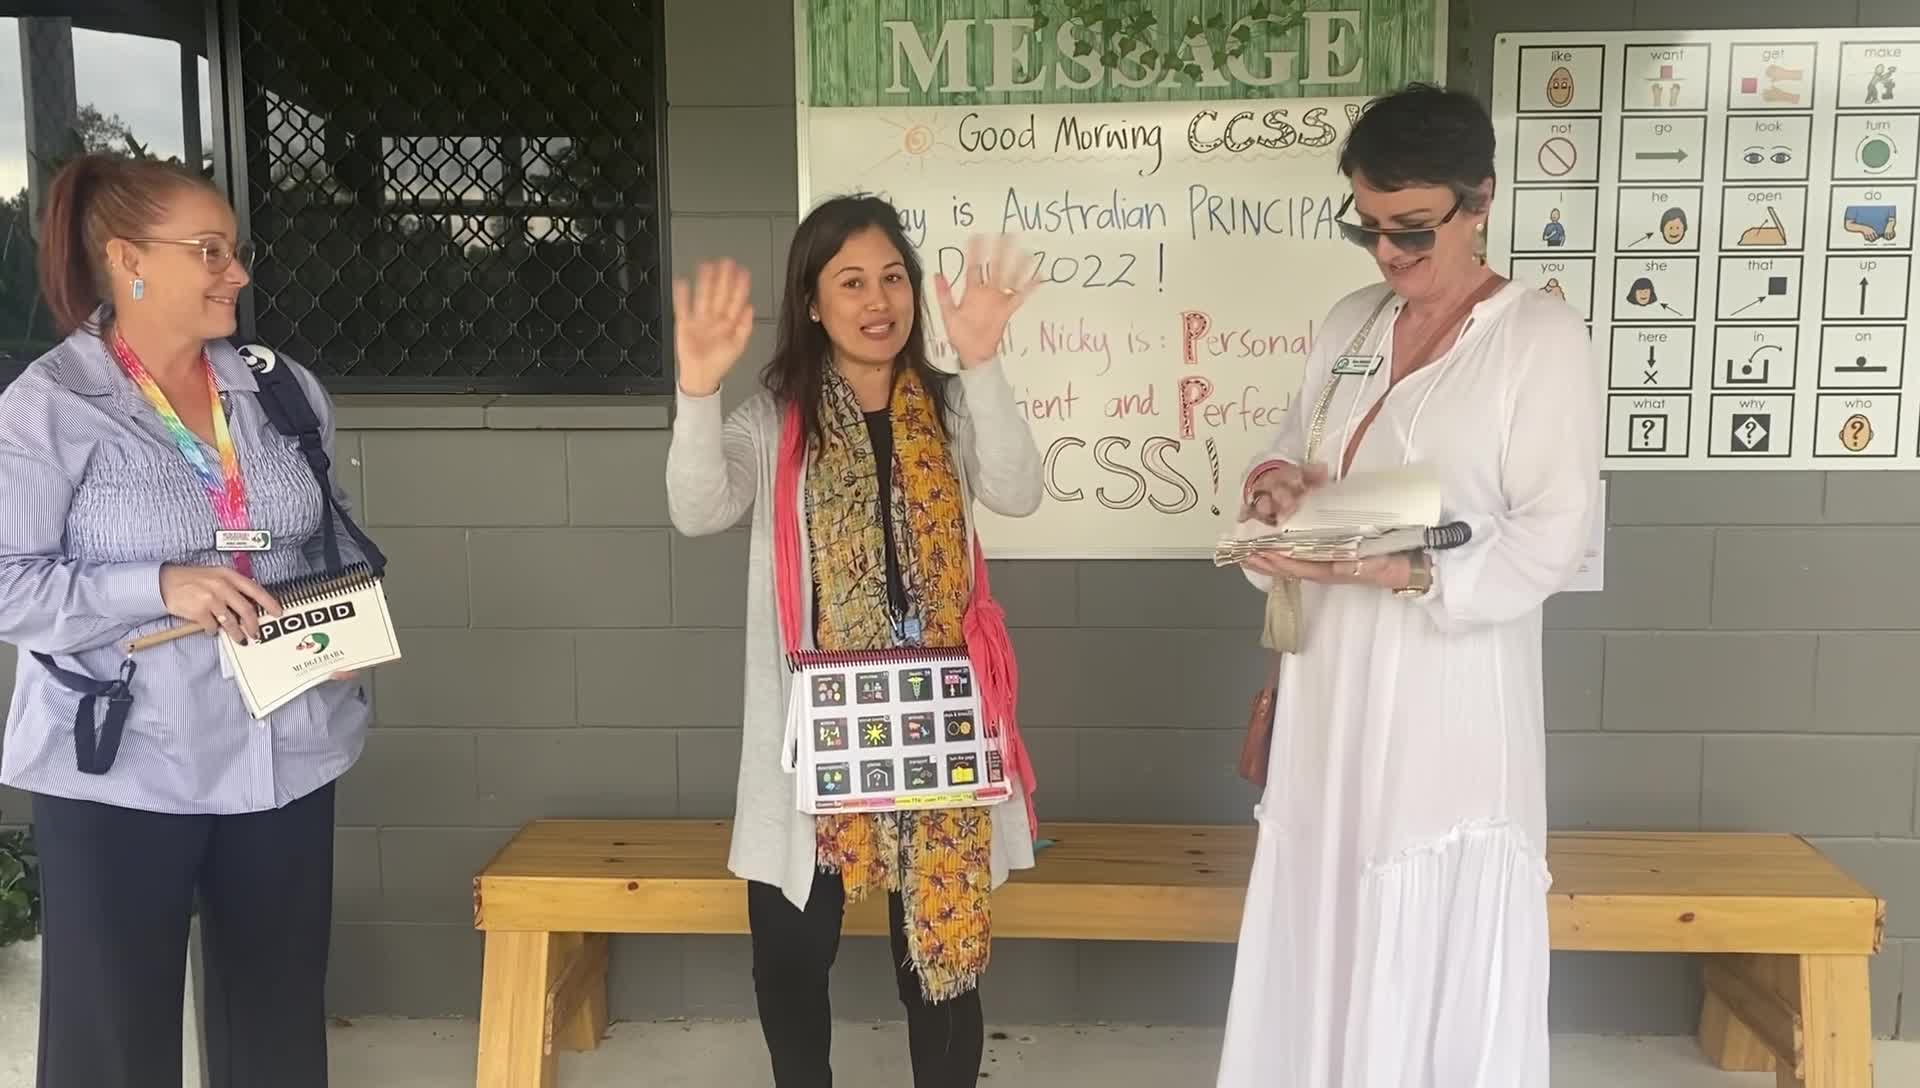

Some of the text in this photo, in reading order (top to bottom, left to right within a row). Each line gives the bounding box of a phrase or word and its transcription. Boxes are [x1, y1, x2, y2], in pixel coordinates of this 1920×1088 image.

[883, 10, 1364, 93] MESSAGE
[1551, 50, 1573, 62] like
[1650, 49, 1685, 62] want
[1762, 48, 1785, 63] get
[1864, 46, 1902, 58] make
[1551, 122, 1572, 134] not
[1654, 123, 1673, 136] go
[1755, 120, 1783, 133] look
[1865, 120, 1891, 131] turn
[958, 113, 1036, 152] Good
[1054, 116, 1163, 177] Morning
[1651, 191, 1669, 203] he
[1748, 190, 1783, 204] open
[1864, 190, 1882, 202] do
[952, 195, 975, 227] is
[1002, 187, 1167, 236] Australian
[1031, 250, 1137, 288] 2022
[1541, 262, 1565, 275] you
[1645, 260, 1668, 272] she
[1748, 259, 1774, 272] that
[1859, 260, 1878, 273] up
[1638, 330, 1668, 343] here
[1754, 331, 1765, 343] in
[1855, 332, 1872, 342] on
[1040, 316, 1112, 377] Nicky
[1180, 311, 1313, 365] Personal
[1104, 383, 1160, 419] and
[1633, 397, 1665, 410] what
[1739, 398, 1766, 411] why
[1845, 397, 1873, 410] who
[261, 604, 351, 640] PODD
